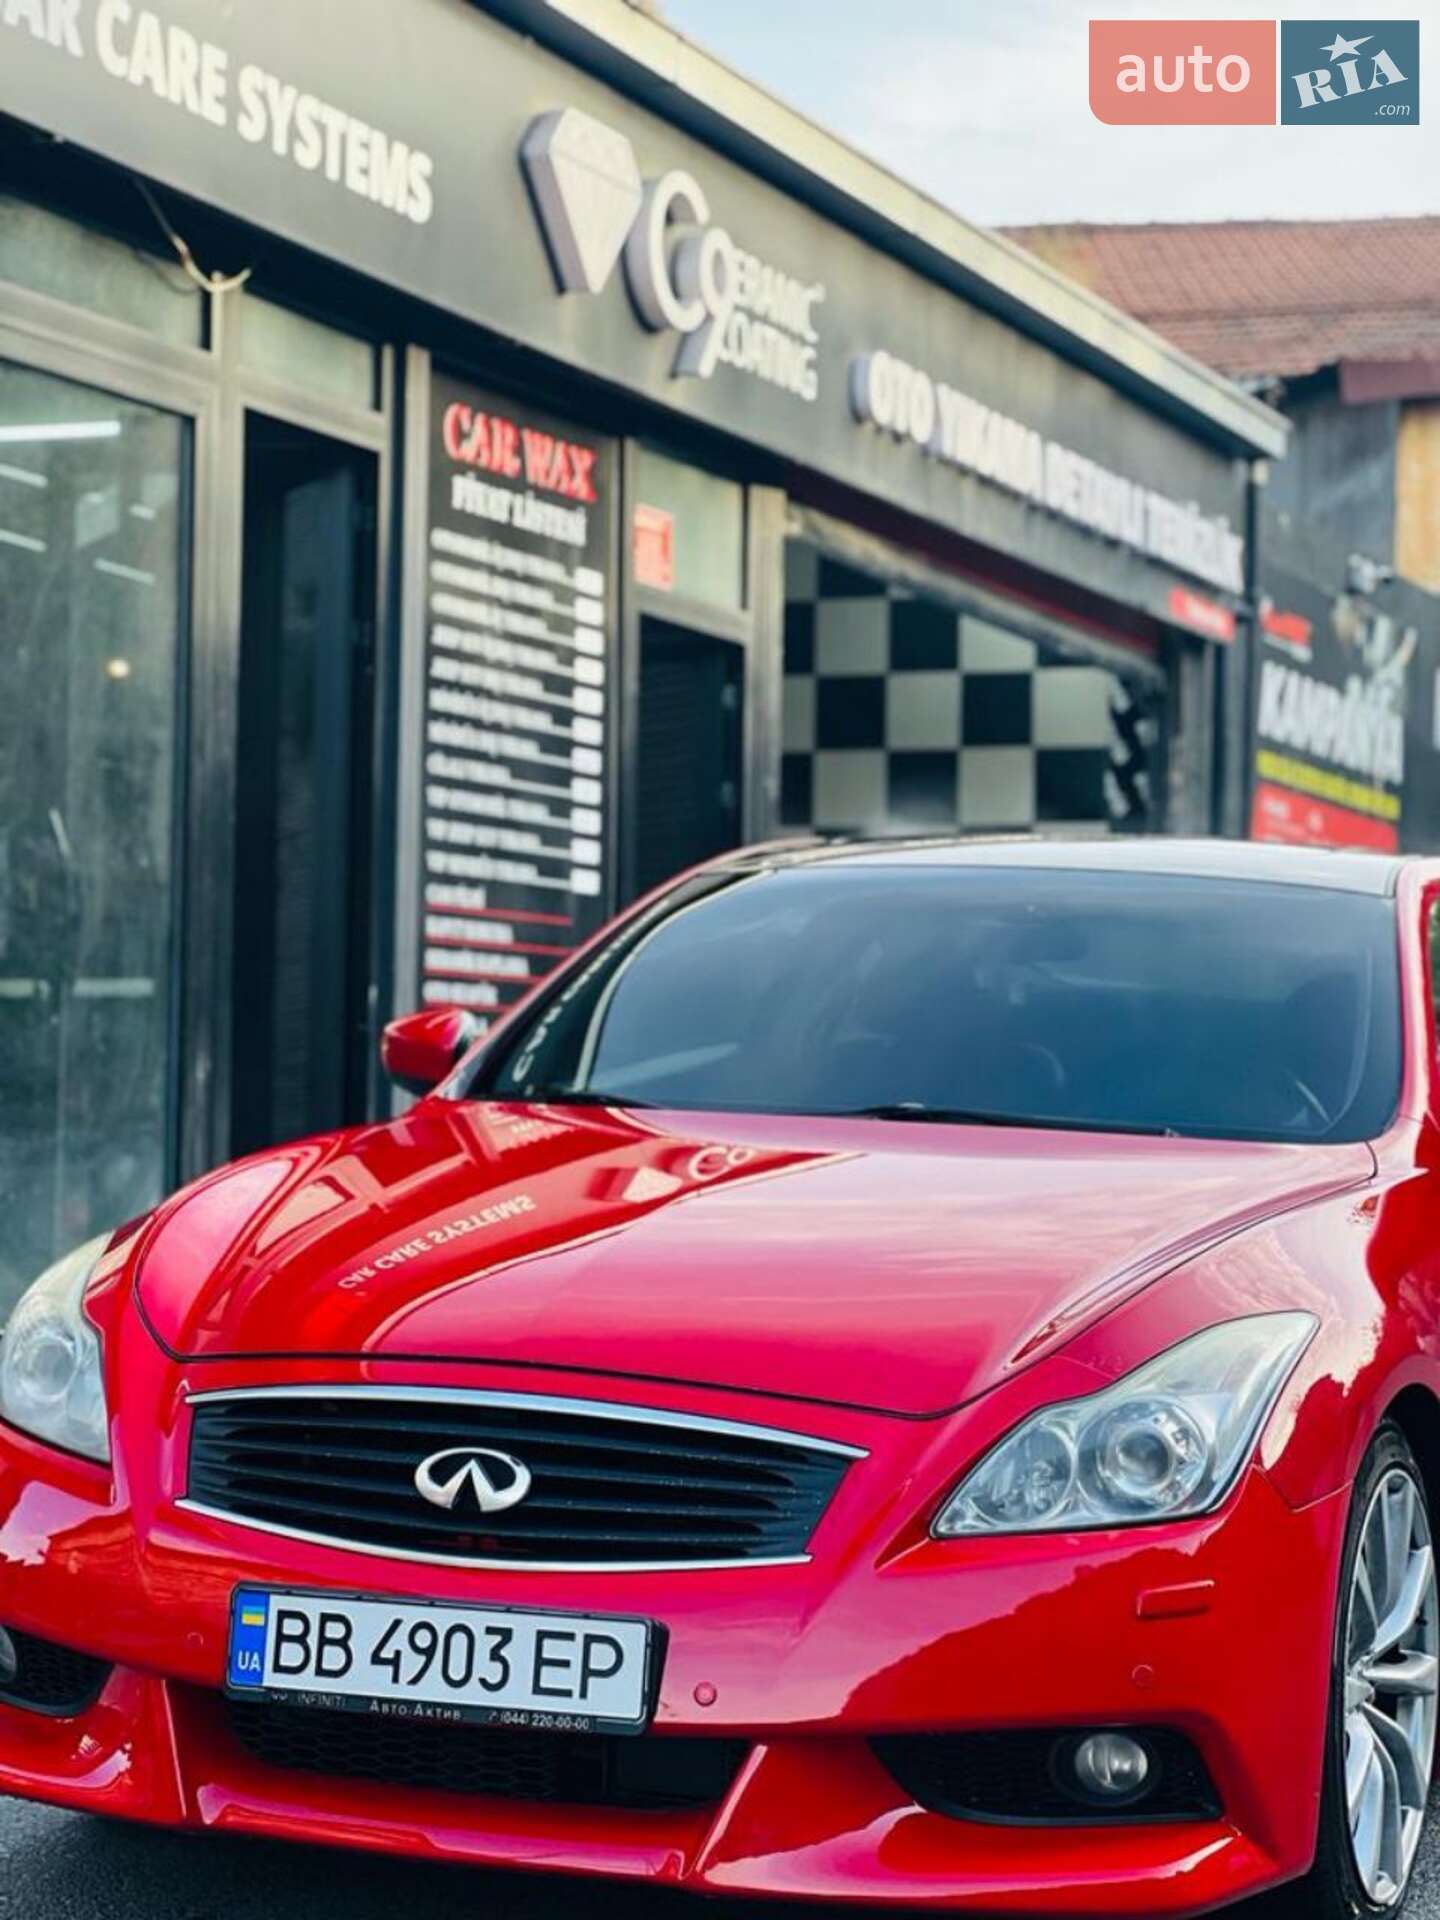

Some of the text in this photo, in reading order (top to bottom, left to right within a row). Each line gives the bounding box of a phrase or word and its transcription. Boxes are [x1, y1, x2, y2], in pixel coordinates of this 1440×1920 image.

[95, 0, 227, 126] CARE
[237, 63, 434, 224] SYSTEMS
[868, 350, 935, 444] OTO
[443, 401, 598, 503] CAR WAX
[237, 1650, 262, 1672] UA
[272, 1609, 625, 1700] BB 4903 EP
[500, 1710, 590, 1730] (044) 220-00-00
